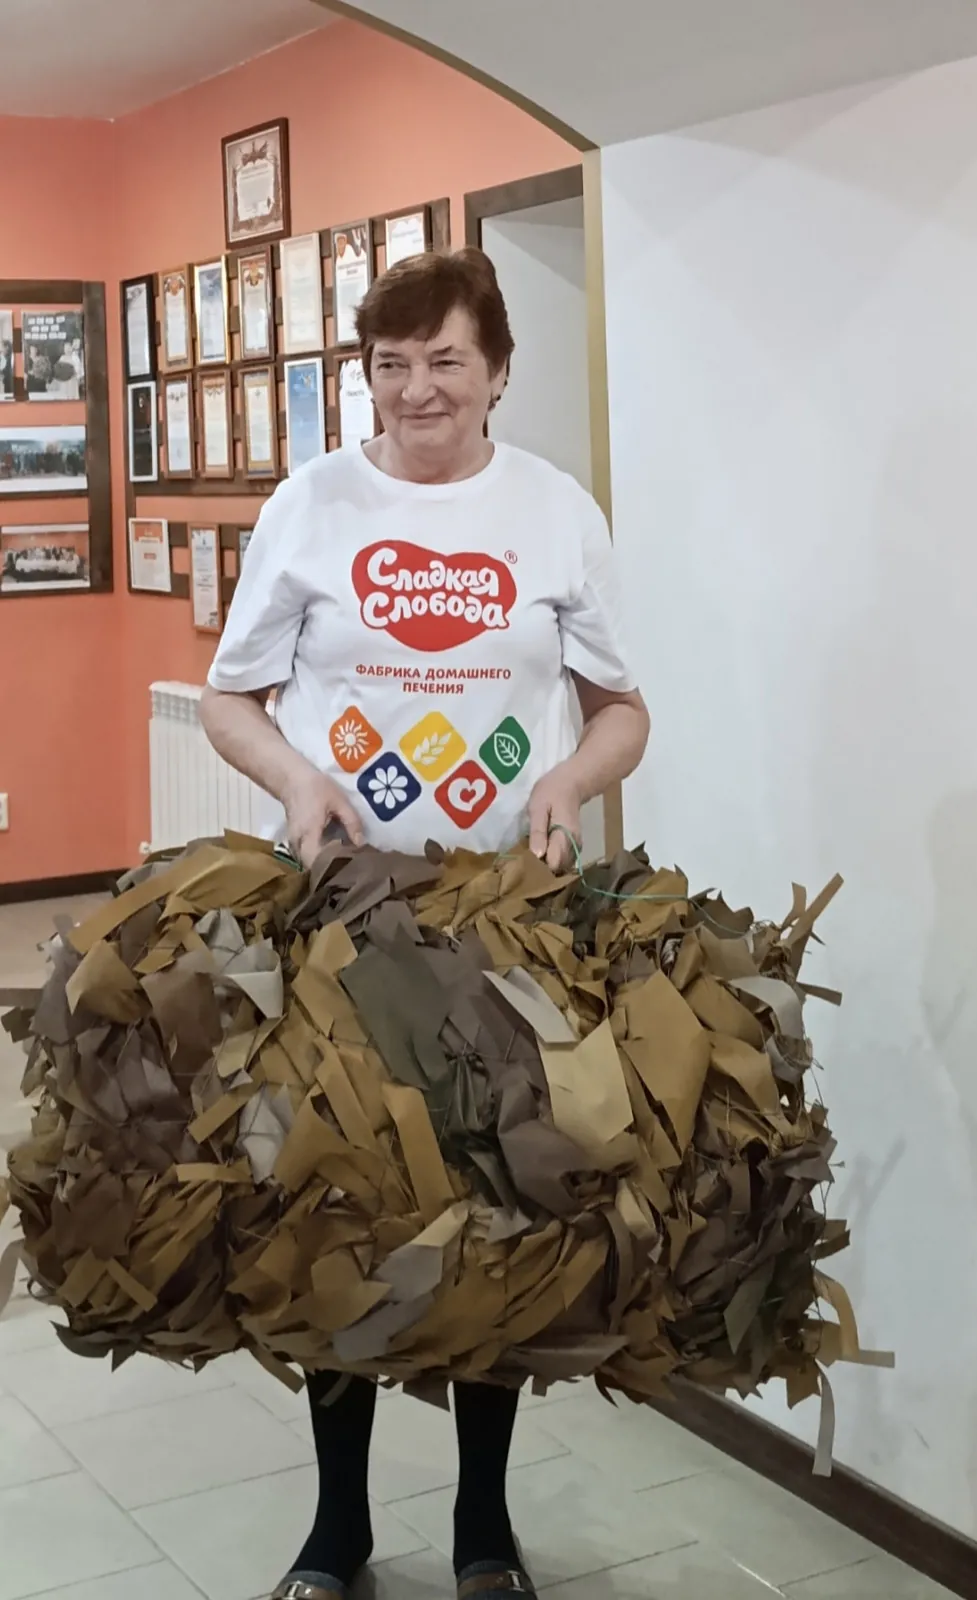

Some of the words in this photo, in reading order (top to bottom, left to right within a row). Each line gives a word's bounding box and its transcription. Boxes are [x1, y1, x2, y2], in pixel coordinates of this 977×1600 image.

[367, 547, 499, 597] Сладкая
[362, 591, 509, 629] Слобода
[355, 664, 421, 679] ФАБРИКА
[425, 667, 512, 680] ДОМАШНЕГО
[402, 682, 465, 694] ПЕЧЕНИЯ
